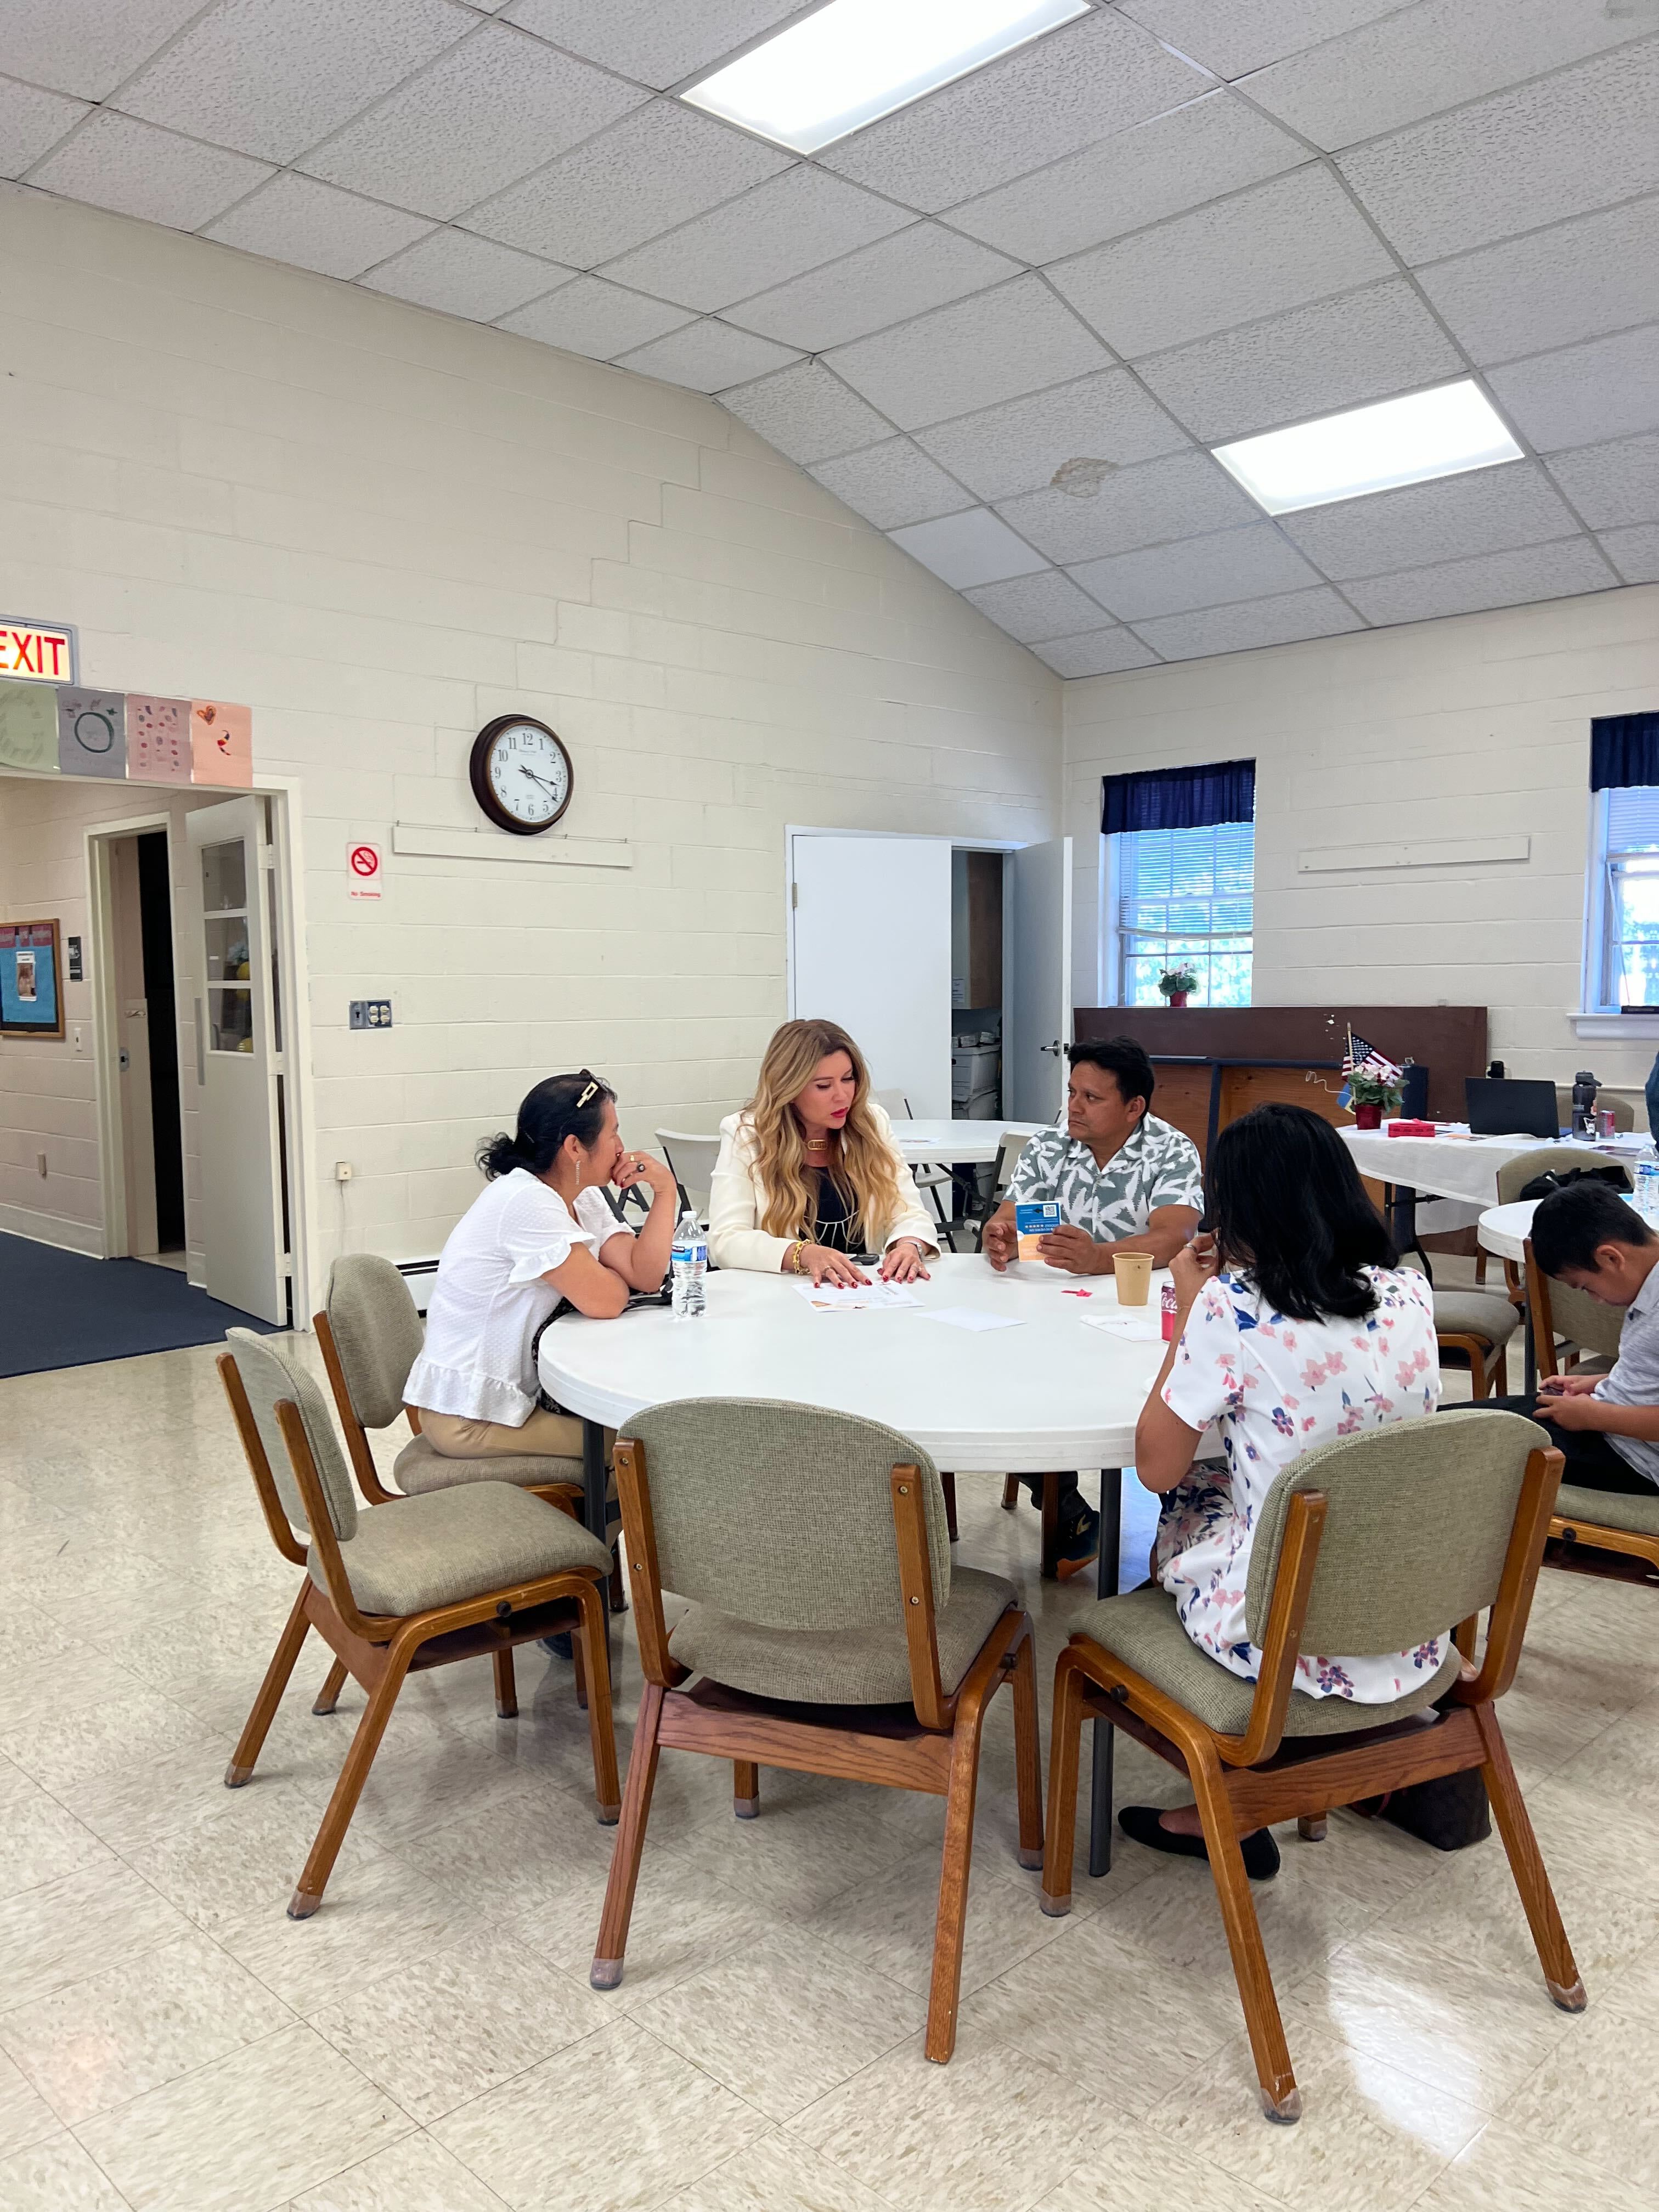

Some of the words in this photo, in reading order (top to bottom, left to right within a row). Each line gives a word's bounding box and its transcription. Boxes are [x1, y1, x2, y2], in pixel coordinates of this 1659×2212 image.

[508, 737, 517, 749] 11
[522, 732, 533, 745] 12
[539, 738, 544, 750] 1
[498, 749, 508, 761] 10
[550, 752, 556, 764] 2
[495, 768, 501, 778] 9
[555, 771, 561, 782] 3
[500, 786, 507, 797] 8
[553, 787, 558, 799] 4
[514, 799, 520, 811] 7
[528, 803, 534, 816] 6
[543, 800, 549, 811] 5
